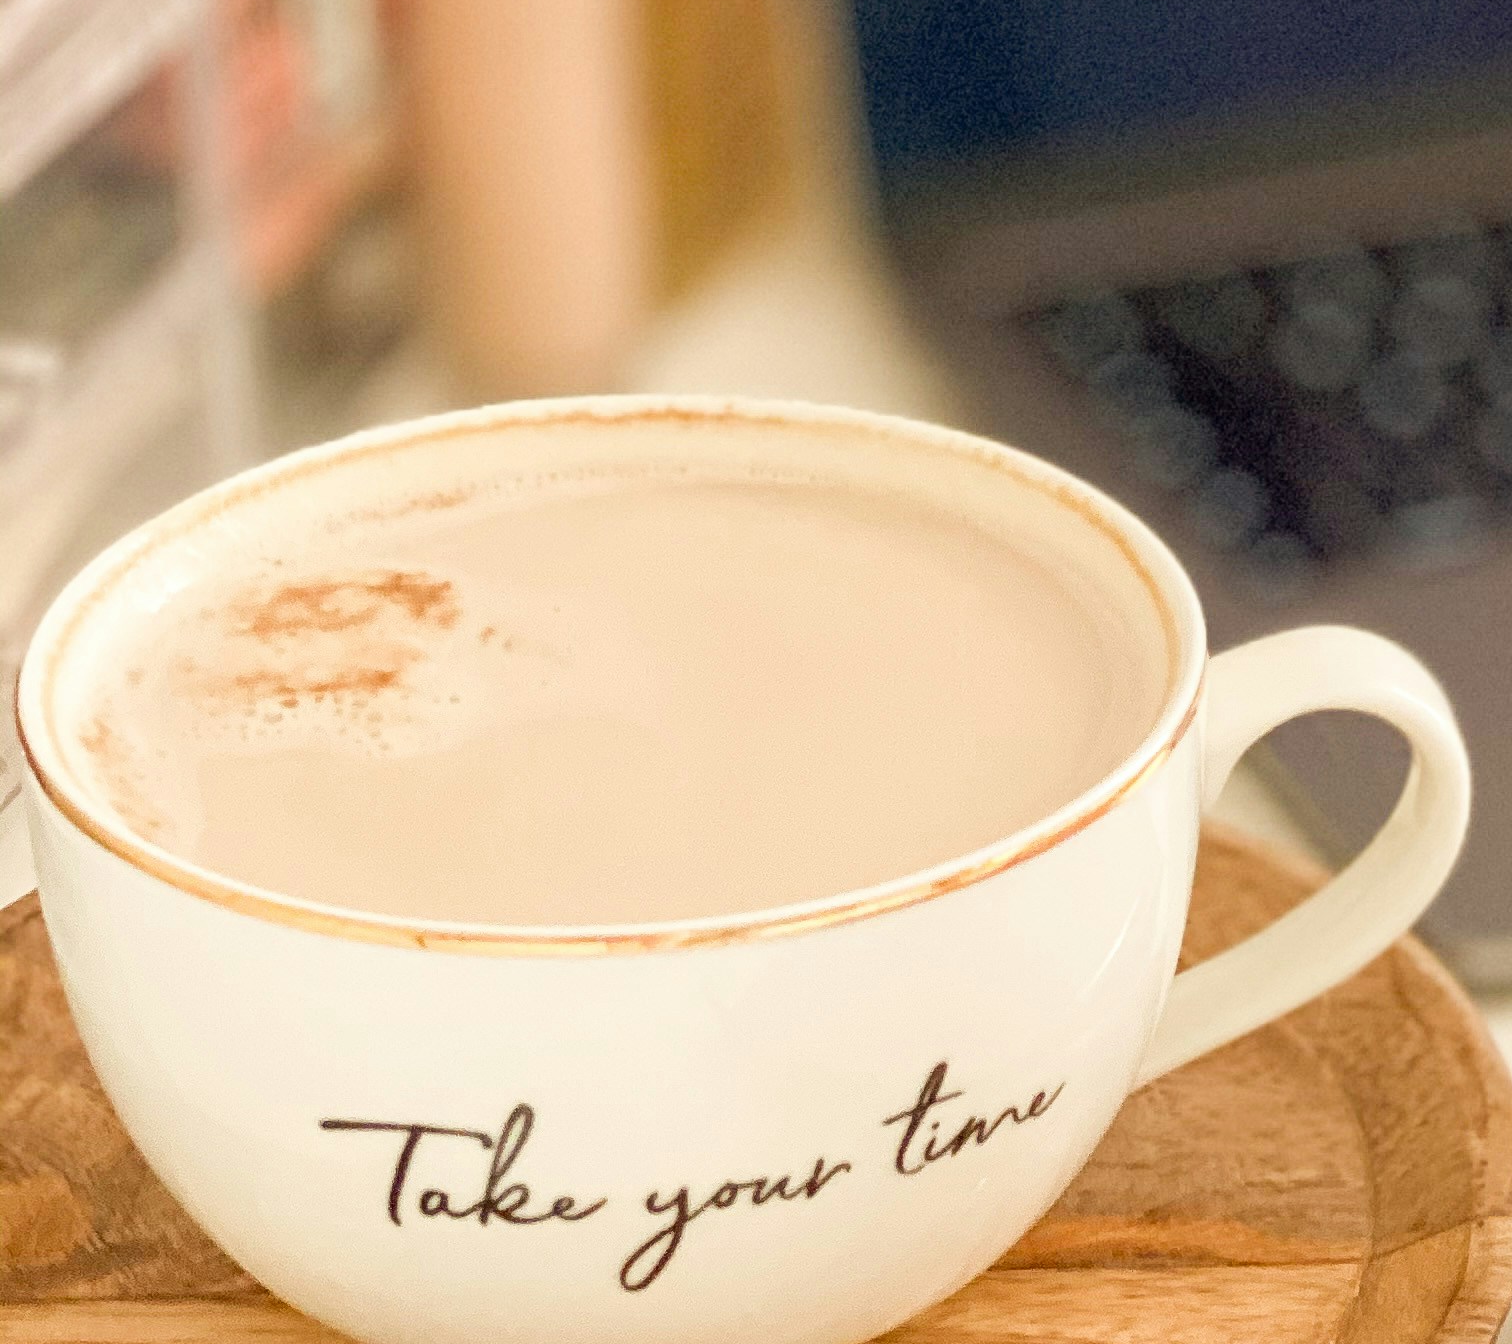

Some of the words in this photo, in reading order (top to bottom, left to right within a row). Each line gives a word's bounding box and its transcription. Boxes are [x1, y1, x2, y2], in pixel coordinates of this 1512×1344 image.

[320, 1102, 607, 1227] Take
[619, 1157, 852, 1293] your
[882, 1060, 1065, 1176] time
